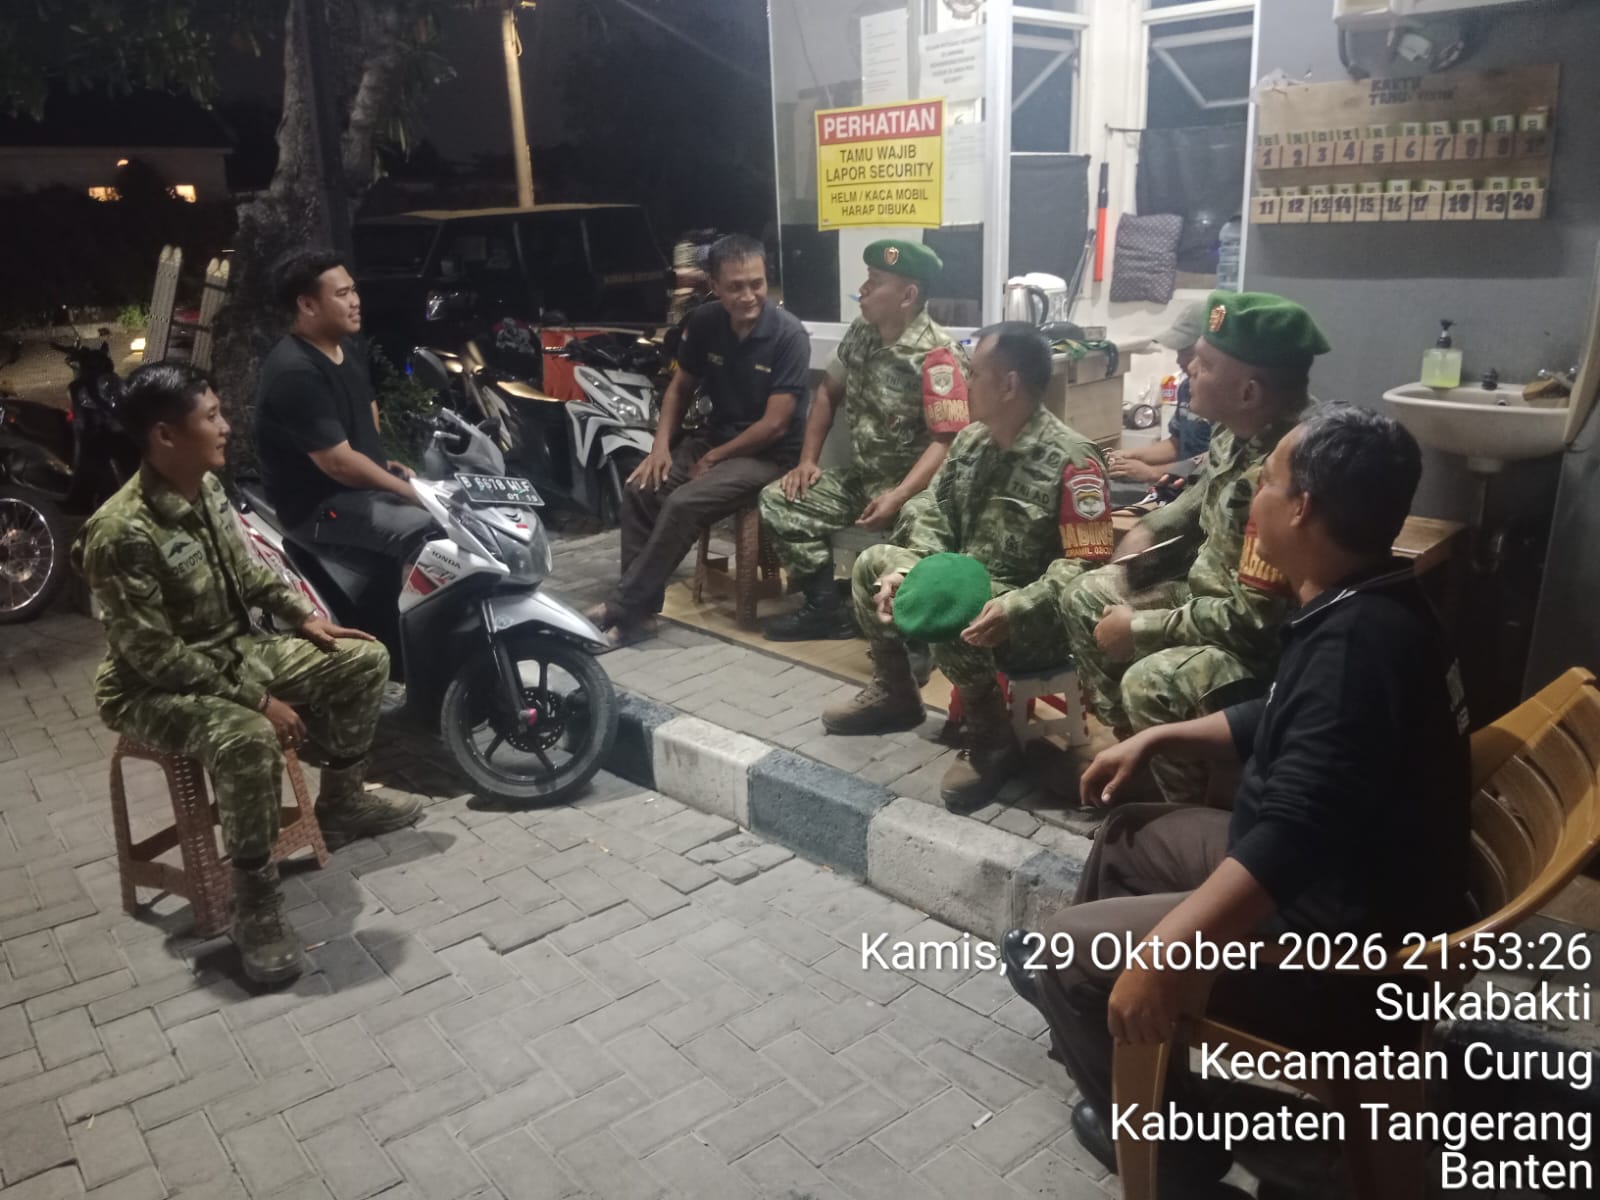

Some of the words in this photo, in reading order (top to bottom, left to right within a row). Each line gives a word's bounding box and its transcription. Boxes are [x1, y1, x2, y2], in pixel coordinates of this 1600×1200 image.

[824, 106, 936, 140] PERHATIAN
[840, 147, 873, 163] TAMU
[877, 144, 917, 160] WAJIB
[1263, 148, 1273, 166] 1
[1293, 149, 1303, 166] 2
[1317, 147, 1328, 162] 3
[1342, 141, 1355, 161] 4
[1372, 143, 1385, 161] 5
[1405, 140, 1416, 159] 6
[1434, 137, 1451, 160] 7
[826, 165, 866, 182] LAPOR
[870, 162, 934, 179] SECURITY
[831, 191, 857, 204] HELM
[865, 189, 893, 201] KACA
[896, 188, 929, 201] MOBIL
[1260, 200, 1274, 215] 11
[1288, 198, 1304, 214] 12
[1312, 197, 1330, 214] 13
[1334, 196, 1352, 214] 14
[1360, 196, 1375, 213] 15
[1387, 195, 1403, 213] 16
[1413, 194, 1429, 212] 17
[1448, 193, 1471, 213] 18
[1485, 193, 1506, 213] 19
[1512, 191, 1535, 211] 20
[841, 204, 875, 217] HARAP
[878, 203, 917, 216] DIBUKA
[460, 476, 473, 489] B
[1036, 488, 1050, 504] AD
[432, 550, 461, 569] HONDA
